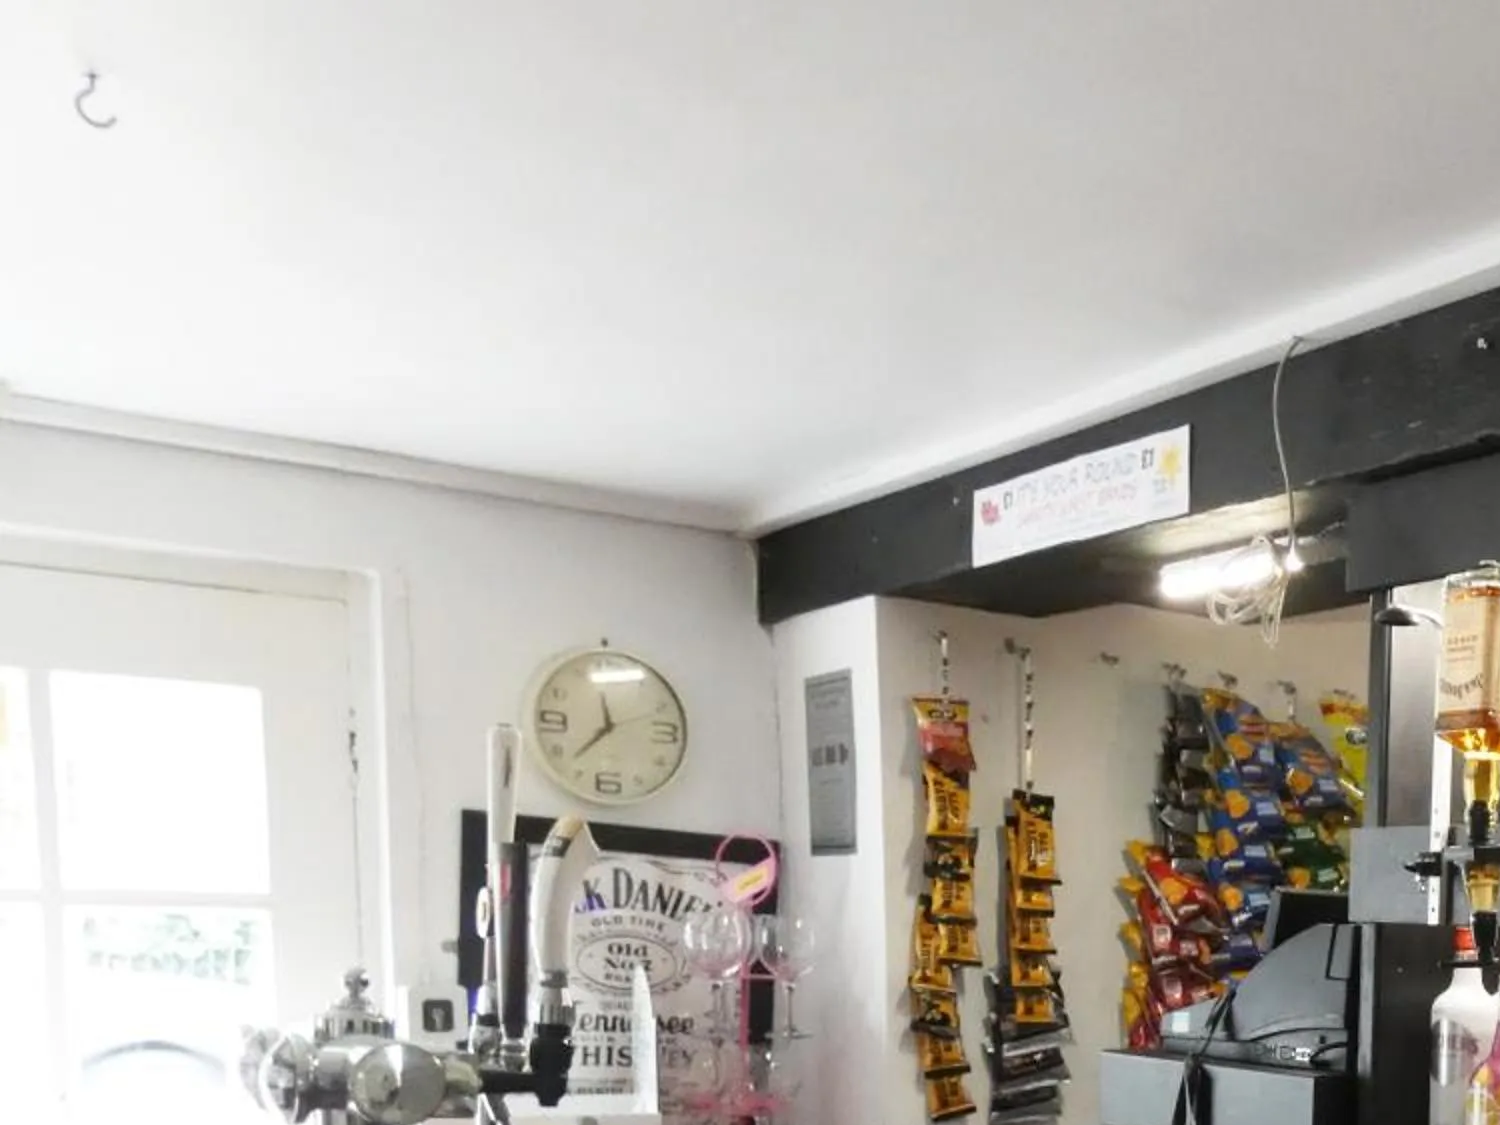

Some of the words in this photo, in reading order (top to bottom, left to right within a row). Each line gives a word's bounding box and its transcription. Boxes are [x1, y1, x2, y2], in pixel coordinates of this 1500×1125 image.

[540, 709, 568, 734] 9
[652, 720, 678, 744] 3
[595, 771, 622, 795] 6
[607, 942, 649, 957] Old
[575, 1044, 693, 1068] HISEY
